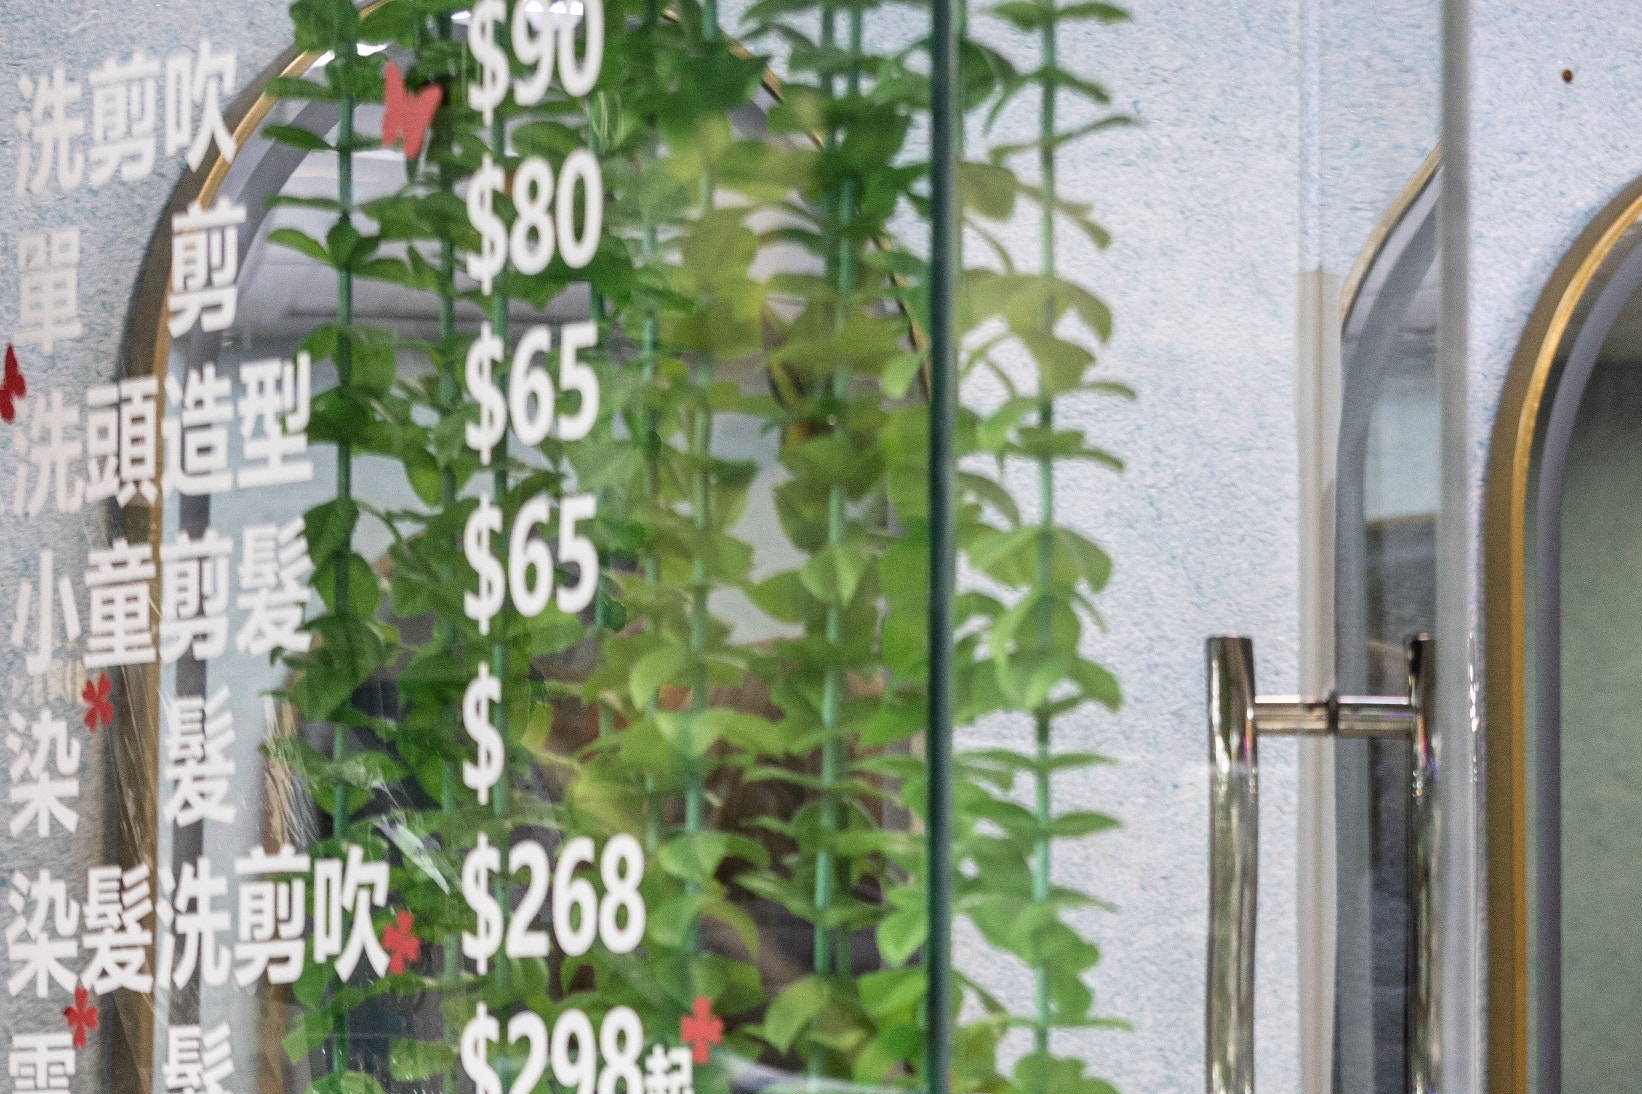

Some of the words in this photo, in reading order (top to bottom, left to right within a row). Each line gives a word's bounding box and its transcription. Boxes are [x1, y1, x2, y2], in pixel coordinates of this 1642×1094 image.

[16, 39, 238, 196] 洗剪吹
[467, 0, 604, 126] $90
[17, 228, 82, 355] 單
[167, 199, 247, 337] 剪
[466, 149, 602, 296] $80
[13, 351, 313, 514] 洗頭造型
[465, 322, 599, 465] $65
[11, 516, 312, 675] 小童剪髮
[464, 492, 598, 635] $65
[7, 709, 81, 837] 染
[163, 686, 236, 828] 髮
[6, 844, 391, 998] 染髮洗剪吹
[461, 831, 645, 975] $268
